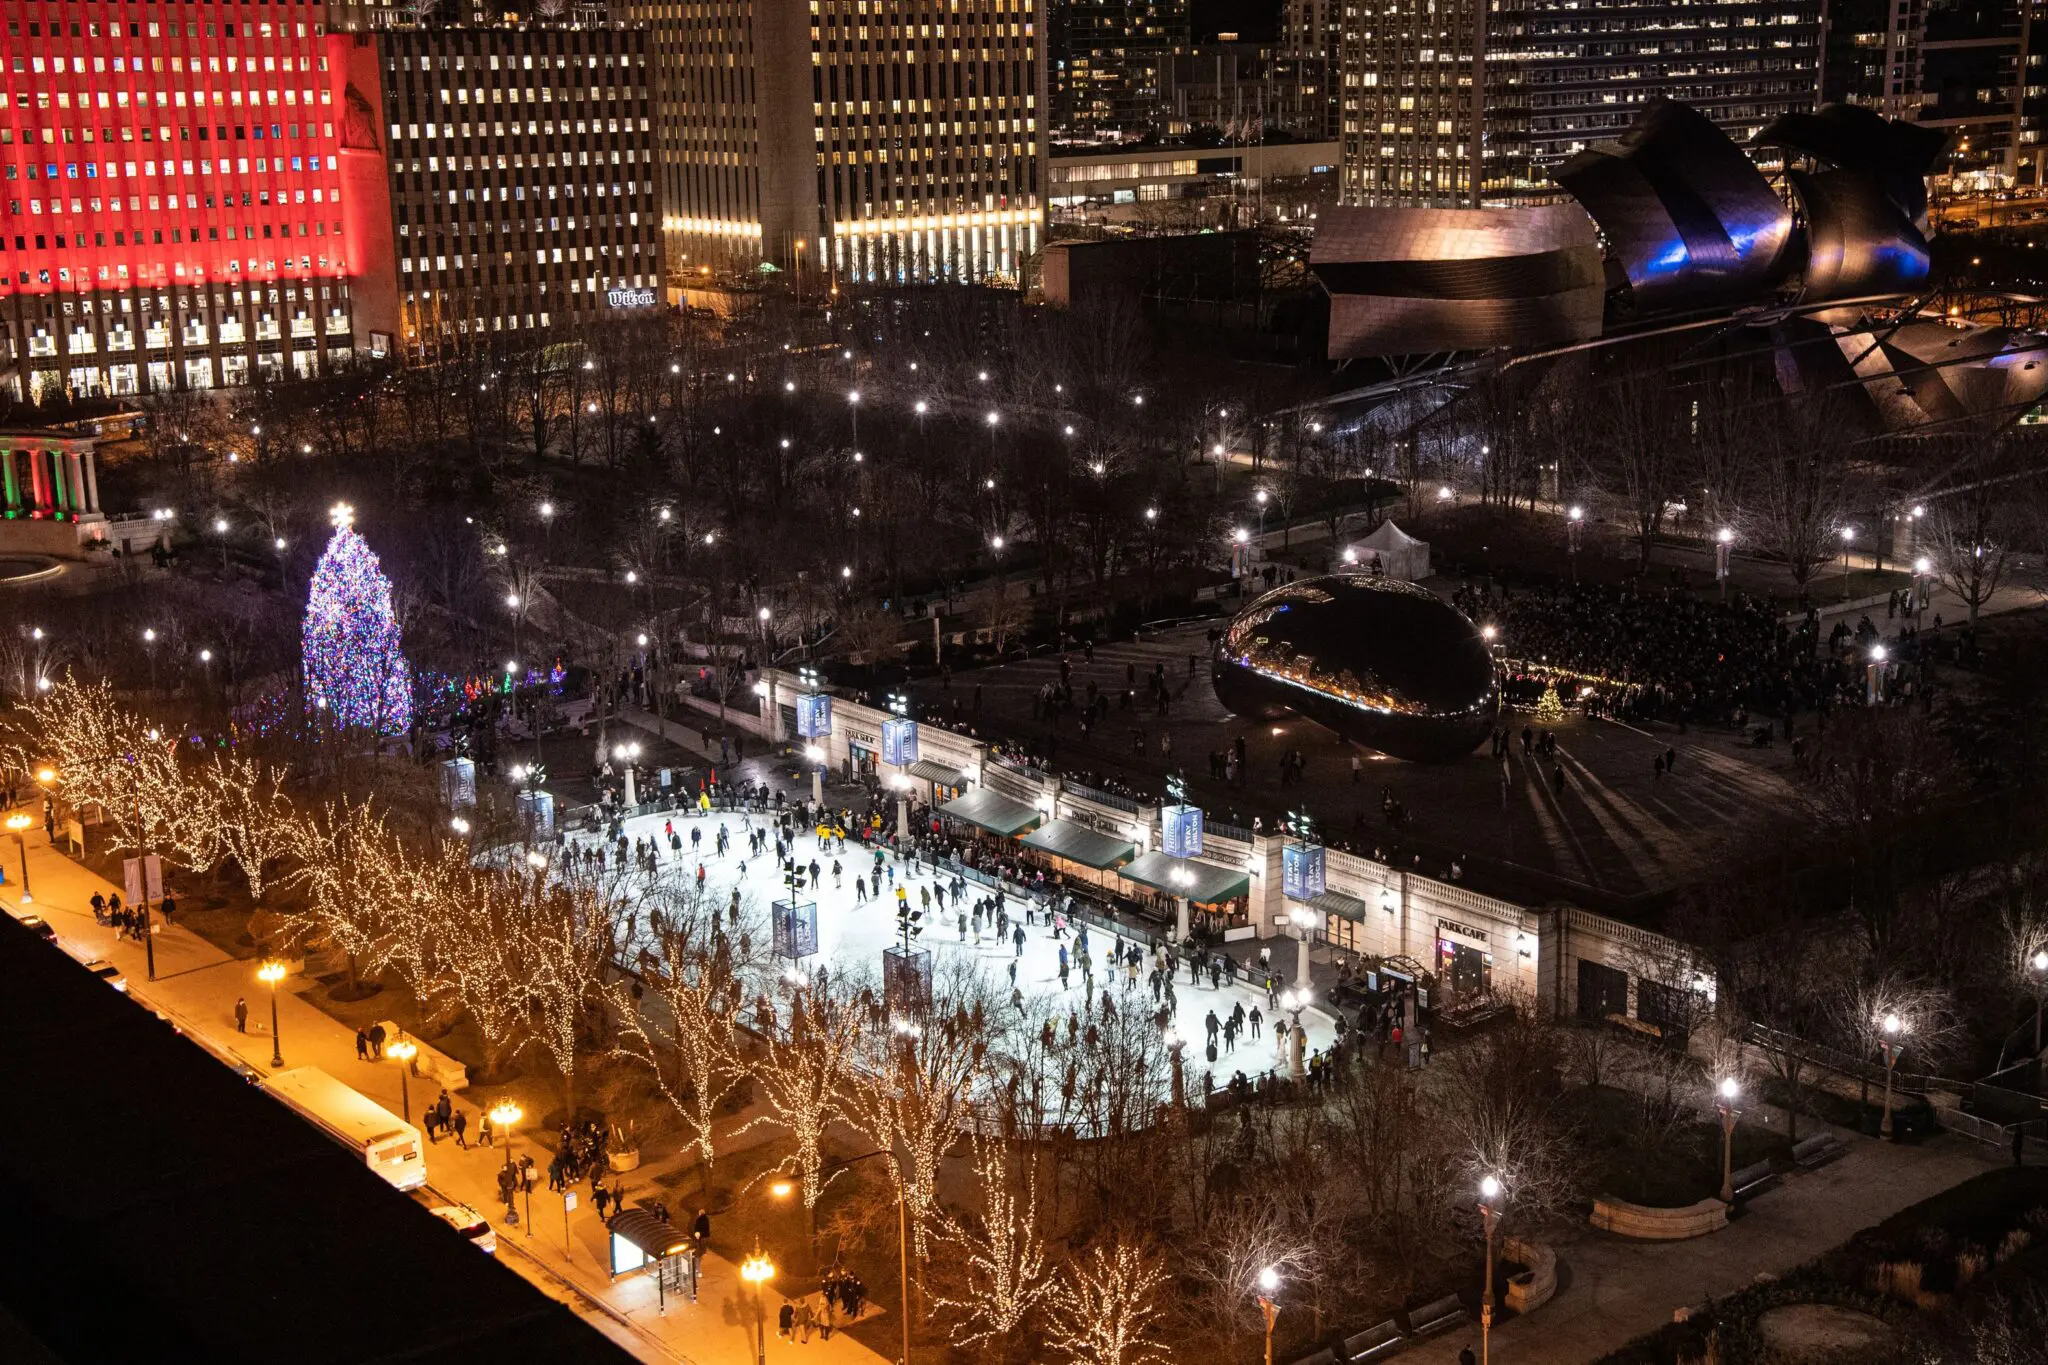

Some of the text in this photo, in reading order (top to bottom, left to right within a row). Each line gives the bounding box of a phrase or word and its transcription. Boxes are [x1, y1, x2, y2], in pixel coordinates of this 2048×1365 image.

[608, 290, 656, 307] Wilson
[1438, 918, 1487, 942] PARK CAFE
